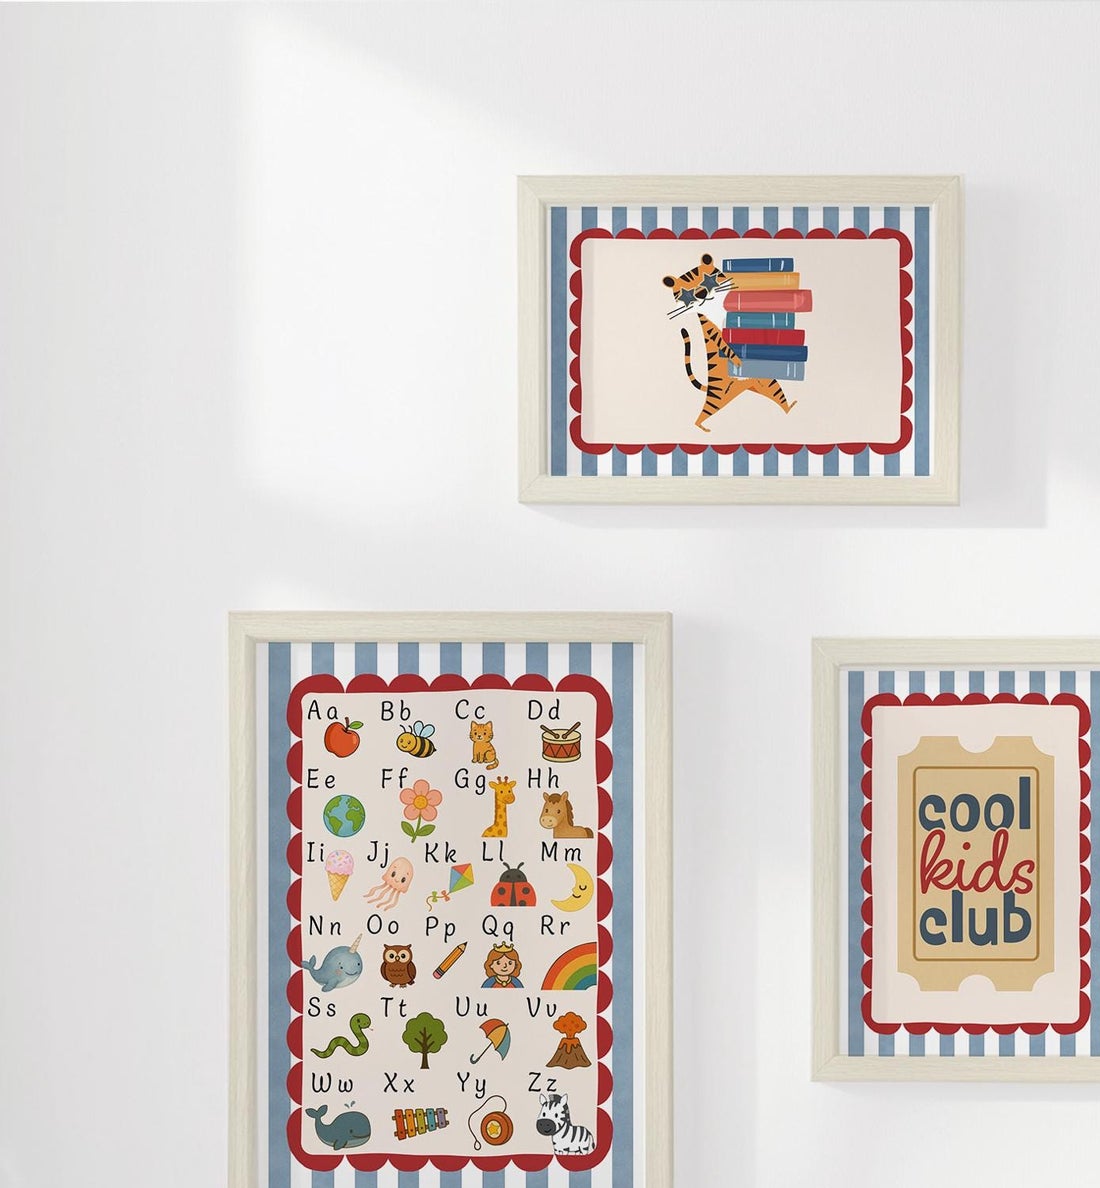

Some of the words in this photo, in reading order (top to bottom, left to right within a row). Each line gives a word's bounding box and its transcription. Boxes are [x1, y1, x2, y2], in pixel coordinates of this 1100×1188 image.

[306, 699, 339, 721] Aa
[380, 700, 412, 722] Bb
[454, 698, 486, 721] Cc
[527, 698, 561, 721] Dd
[306, 768, 336, 789] Ee
[381, 767, 408, 789] Ff
[454, 768, 487, 796] Gg
[527, 767, 560, 789] Hh
[918, 776, 1031, 833] cool
[306, 841, 325, 864] Ii
[366, 840, 390, 869] Jj
[424, 842, 457, 864] Kk
[481, 840, 504, 862] Ll
[540, 841, 582, 862] Mm
[920, 828, 1035, 895] kids
[308, 915, 342, 936] Nn
[366, 914, 400, 935] Oo
[425, 916, 456, 943] Pp
[481, 914, 514, 942] Qq
[540, 914, 571, 936] Rr
[919, 889, 1032, 946] club
[307, 996, 337, 1018] Ss
[380, 997, 408, 1018] Tt
[455, 996, 489, 1017] Uu
[526, 997, 558, 1018] Vv
[311, 1072, 354, 1093] Ww
[383, 1072, 416, 1093] Xx
[456, 1071, 487, 1099] Yy
[527, 1072, 558, 1093] Zz
